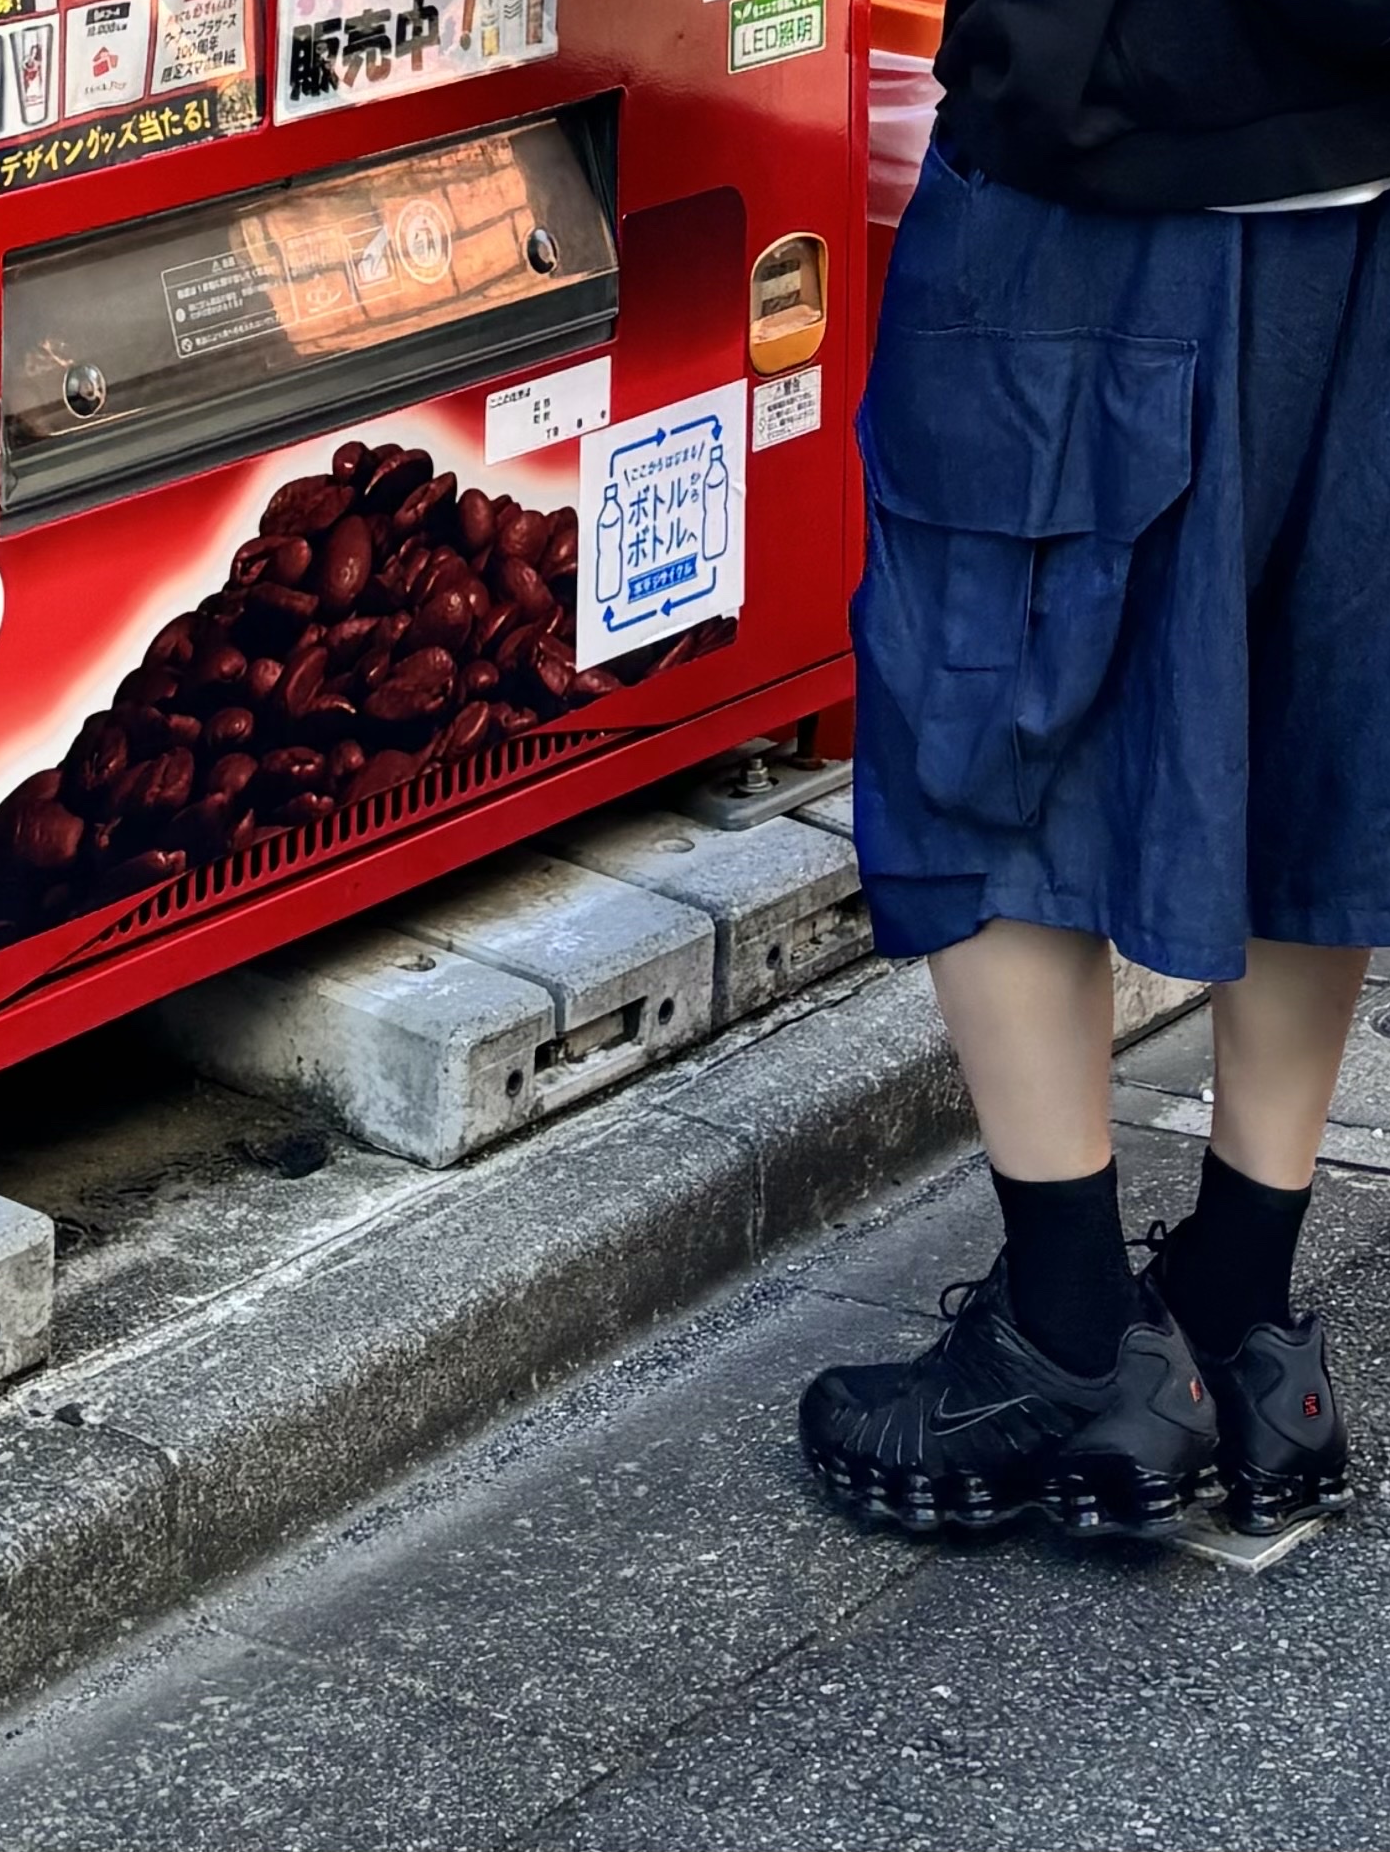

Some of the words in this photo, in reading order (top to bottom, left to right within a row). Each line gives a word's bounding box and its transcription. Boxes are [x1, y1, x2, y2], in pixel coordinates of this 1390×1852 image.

[741, 13, 814, 57] LED照明
[628, 476, 689, 528] ボトル
[627, 516, 698, 568] ボトルへ
